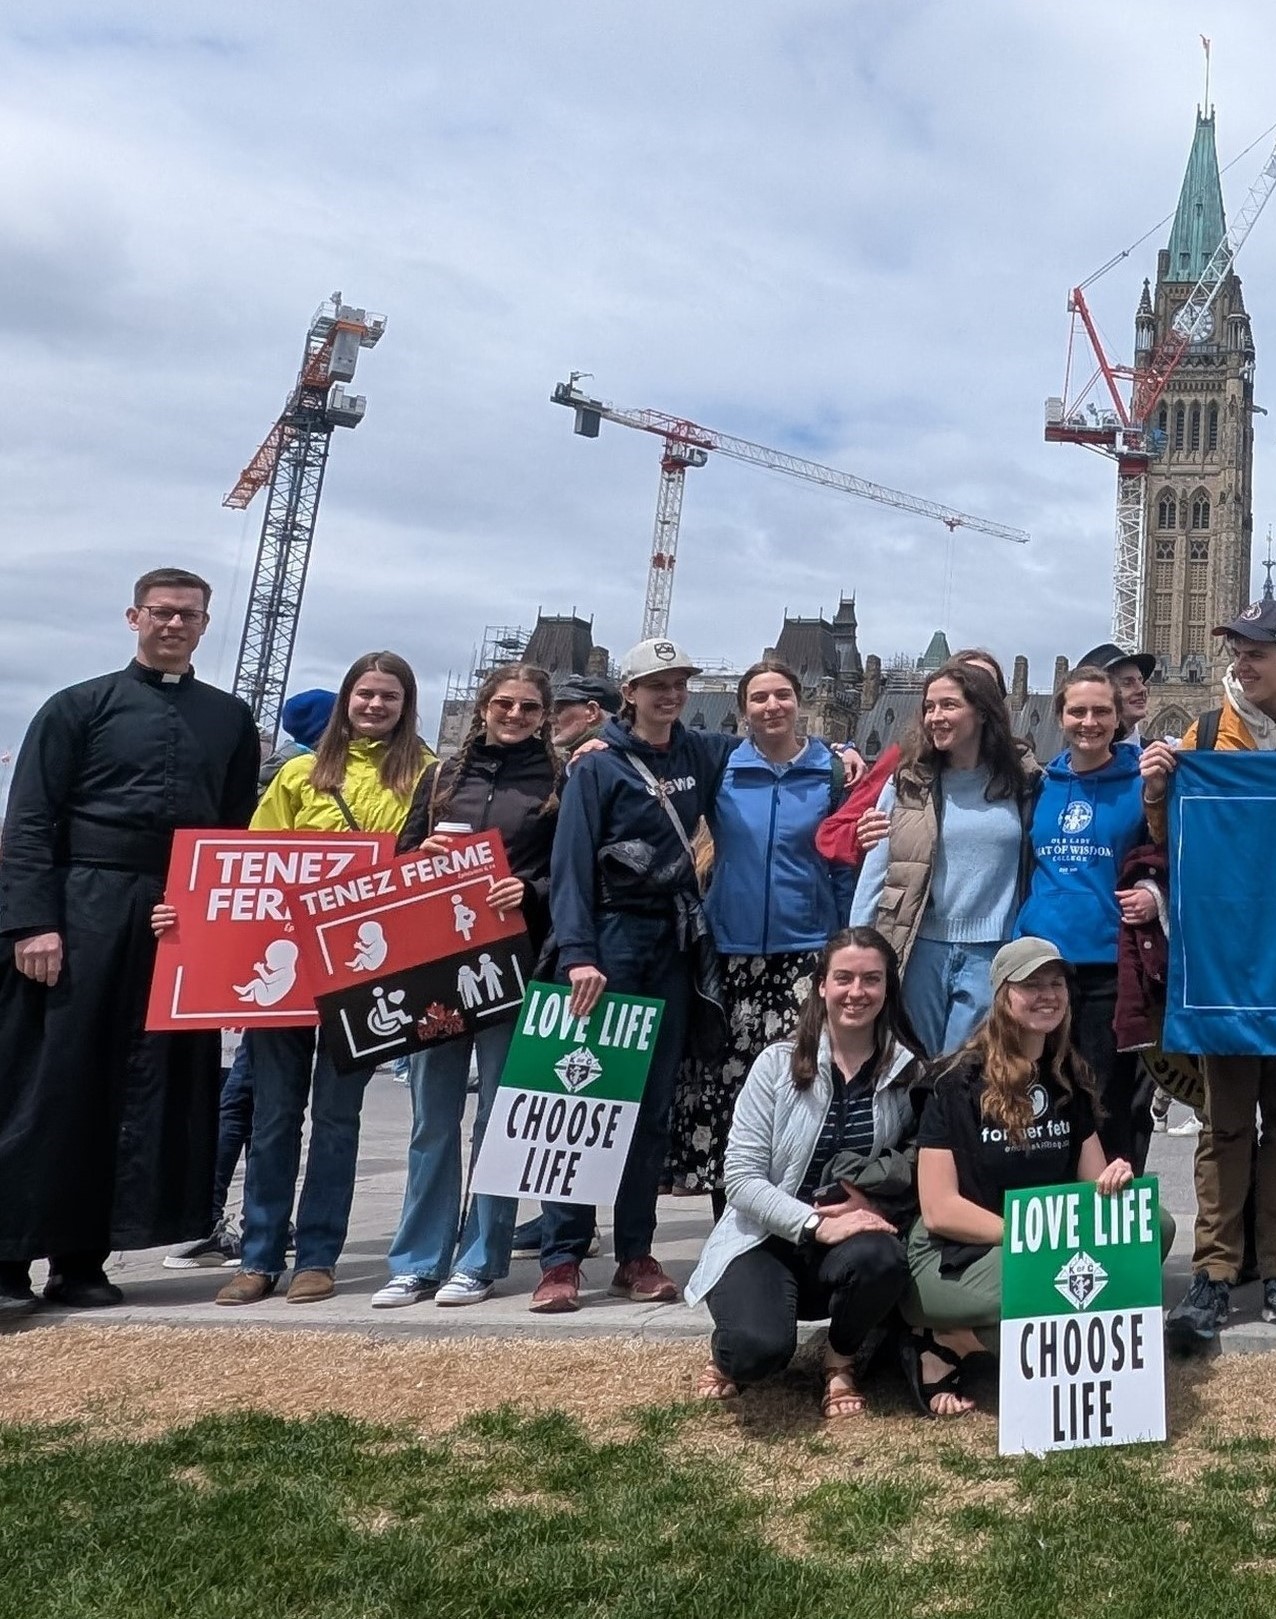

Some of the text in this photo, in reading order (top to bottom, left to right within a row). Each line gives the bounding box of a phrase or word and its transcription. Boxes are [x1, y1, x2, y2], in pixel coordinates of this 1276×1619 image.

[215, 852, 355, 885] TENEZ
[299, 841, 494, 916] TENEZ FERME
[206, 888, 292, 921] FER
[598, 1001, 657, 1051] LIFE
[506, 1093, 622, 1149] CHOOSE
[518, 1147, 582, 1196] LIFE
[1010, 1187, 1153, 1254] LOVE LIFE
[1020, 1313, 1144, 1380] CHOOSE
[1053, 1380, 1113, 1442] LIFE
